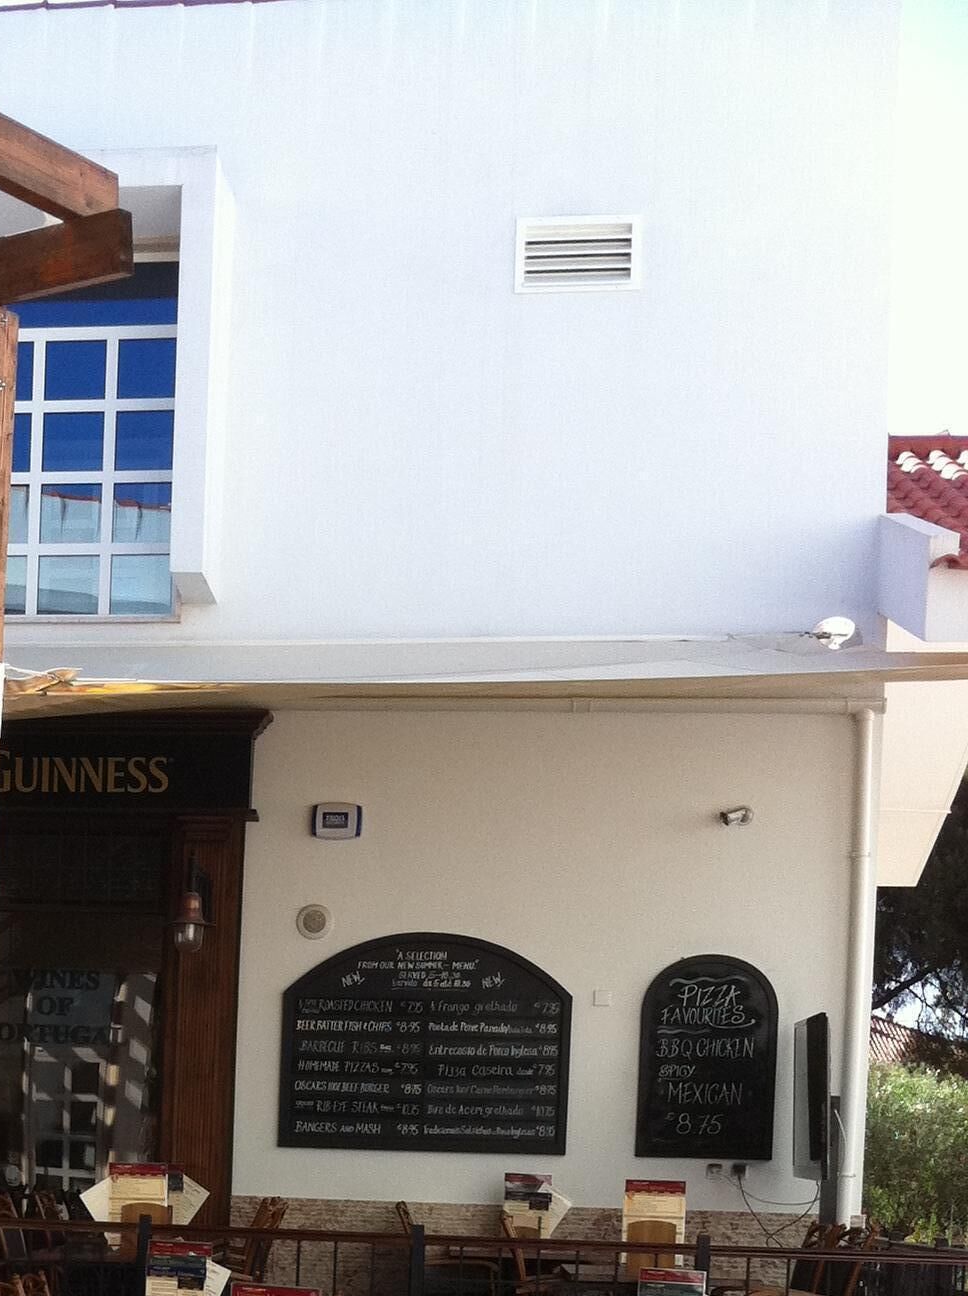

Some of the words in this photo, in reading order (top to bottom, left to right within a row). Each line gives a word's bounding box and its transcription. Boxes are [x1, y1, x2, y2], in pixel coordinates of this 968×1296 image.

[12, 968, 101, 991] WINES
[37, 996, 74, 1016] OF
[353, 999, 393, 1013] CHICKEN
[676, 983, 741, 1008] PIZZA
[660, 1004, 749, 1027] FAVOURITES
[656, 1037, 693, 1060] BBQ
[696, 1037, 755, 1059] CHICKEN
[667, 1082, 744, 1105] MEXICAN
[294, 1120, 338, 1133] BANGERS
[355, 1122, 382, 1135] MASH
